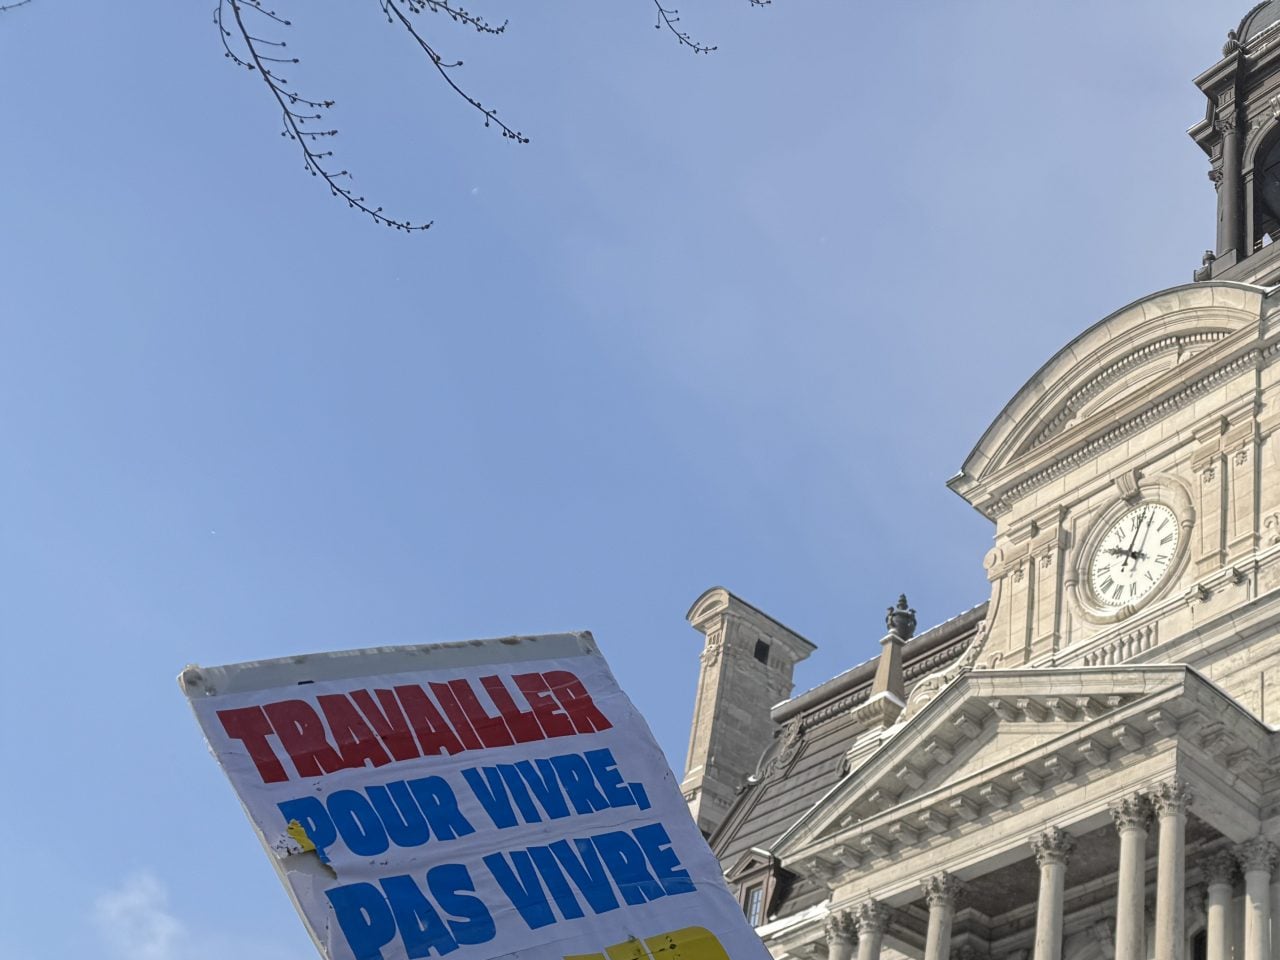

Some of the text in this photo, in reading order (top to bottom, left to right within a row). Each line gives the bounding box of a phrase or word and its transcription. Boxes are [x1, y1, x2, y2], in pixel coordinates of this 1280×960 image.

[217, 670, 613, 783] TRAVAILLER
[277, 747, 652, 865] POUR VIVRE,
[483, 822, 698, 930] VIVRE
